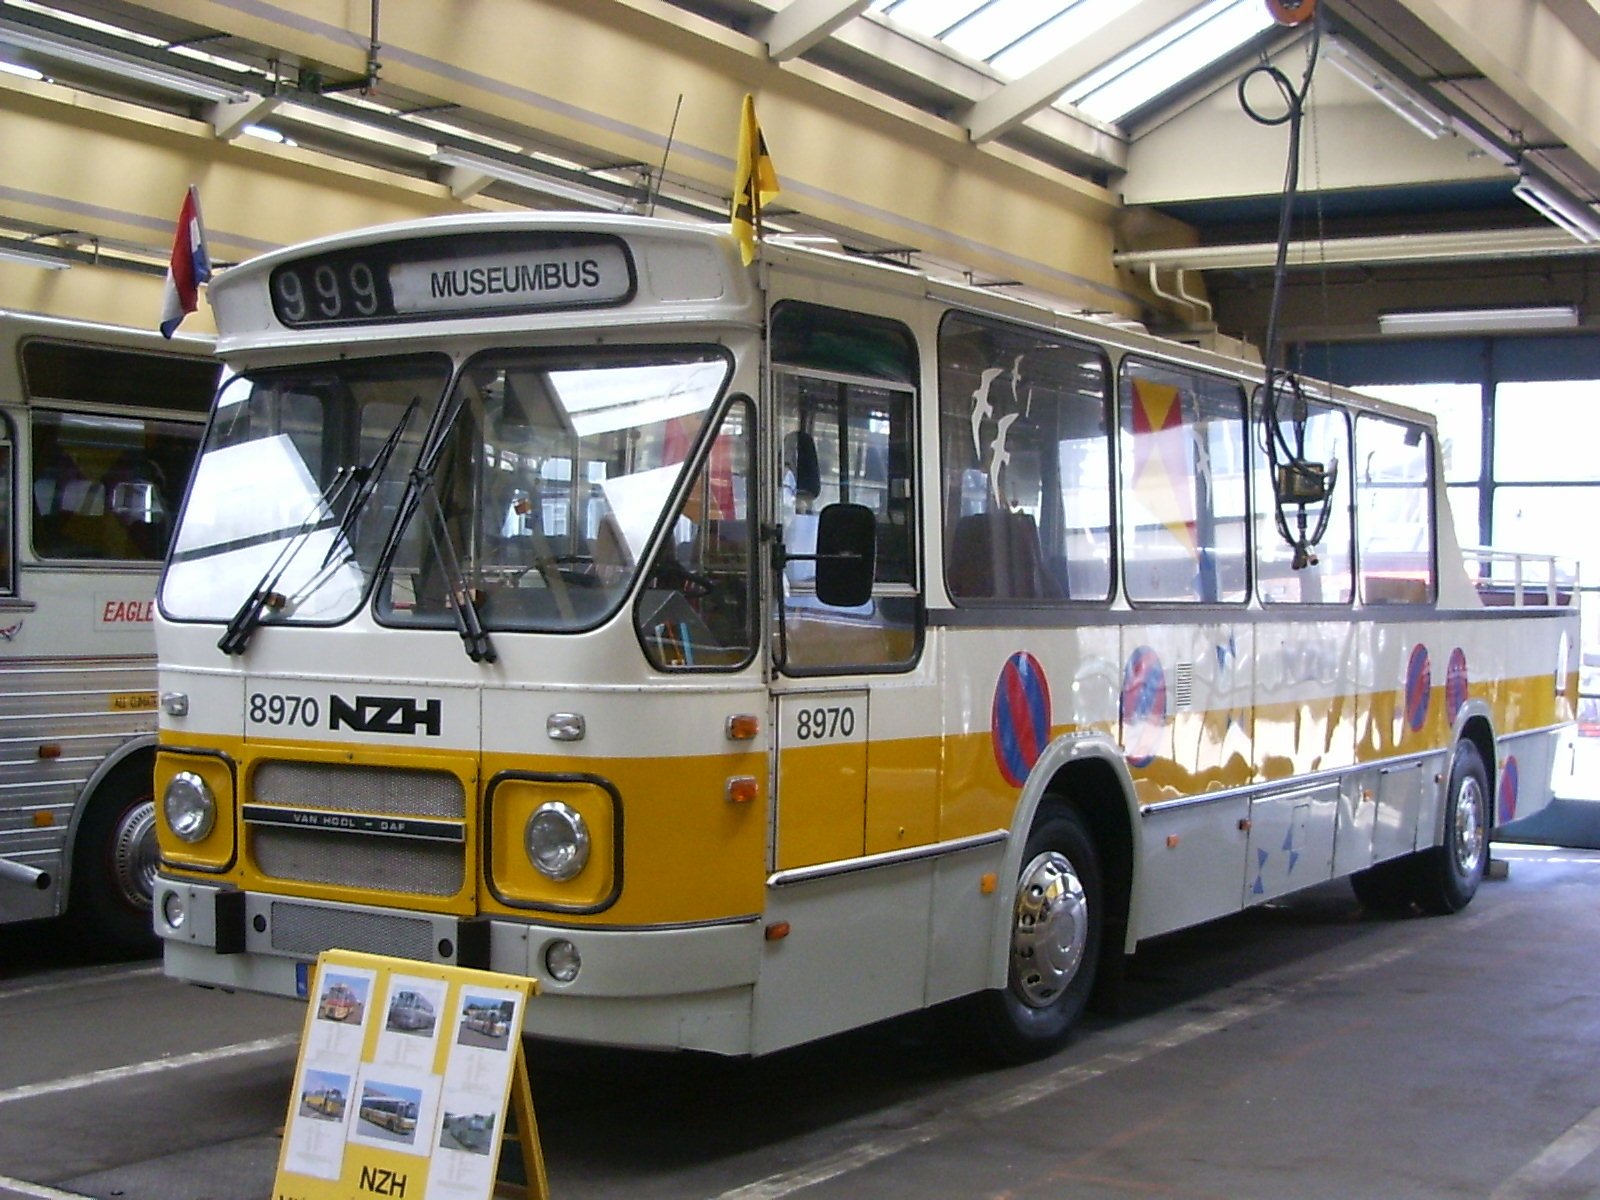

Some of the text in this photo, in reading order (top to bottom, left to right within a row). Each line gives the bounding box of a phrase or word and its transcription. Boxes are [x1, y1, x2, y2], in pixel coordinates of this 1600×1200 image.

[431, 259, 599, 299] MUSEUMBUS
[250, 692, 441, 736] 8970 NZH
[797, 706, 855, 740] 8970
[293, 813, 318, 824] VAN
[323, 816, 356, 828] HOOL
[380, 822, 406, 832] DAF
[359, 1165, 407, 1199] NZH
